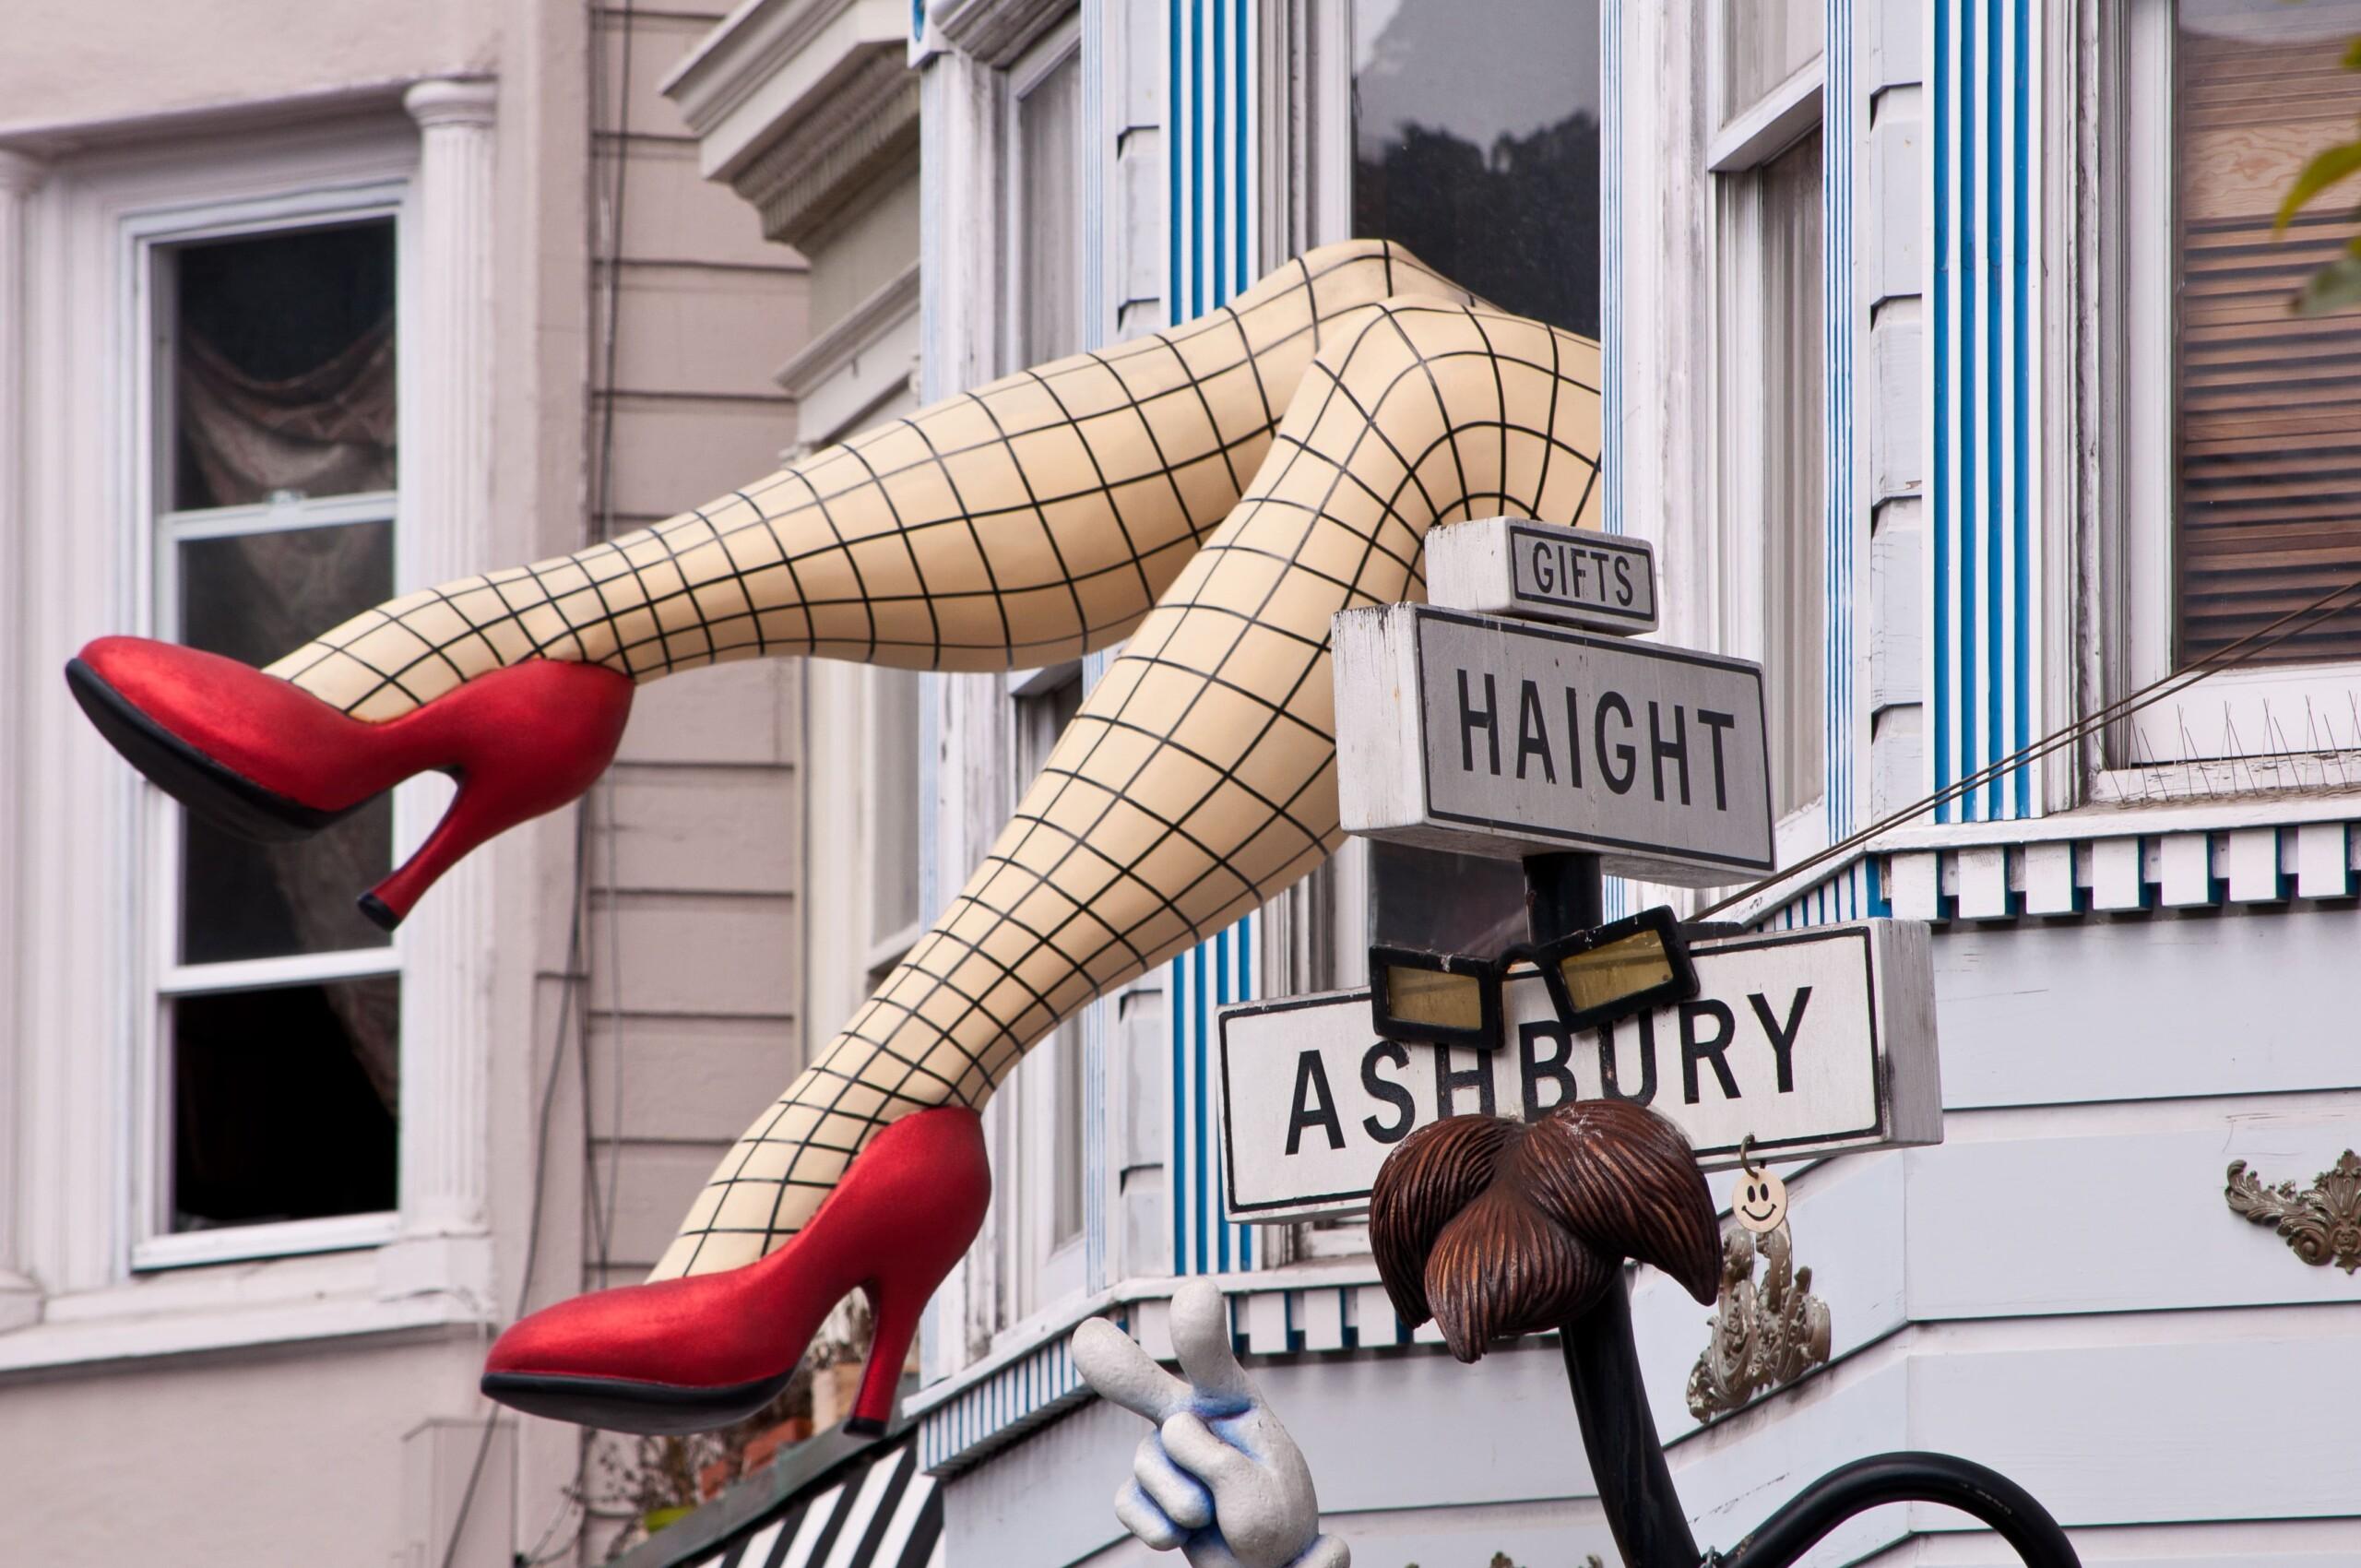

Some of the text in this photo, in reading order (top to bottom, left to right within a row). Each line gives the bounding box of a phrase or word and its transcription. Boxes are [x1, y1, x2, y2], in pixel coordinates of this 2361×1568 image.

[1532, 541, 1633, 606] GIFTS
[1457, 669, 1735, 812] HAIGHT
[1285, 986, 1812, 1157] ASHBURY
